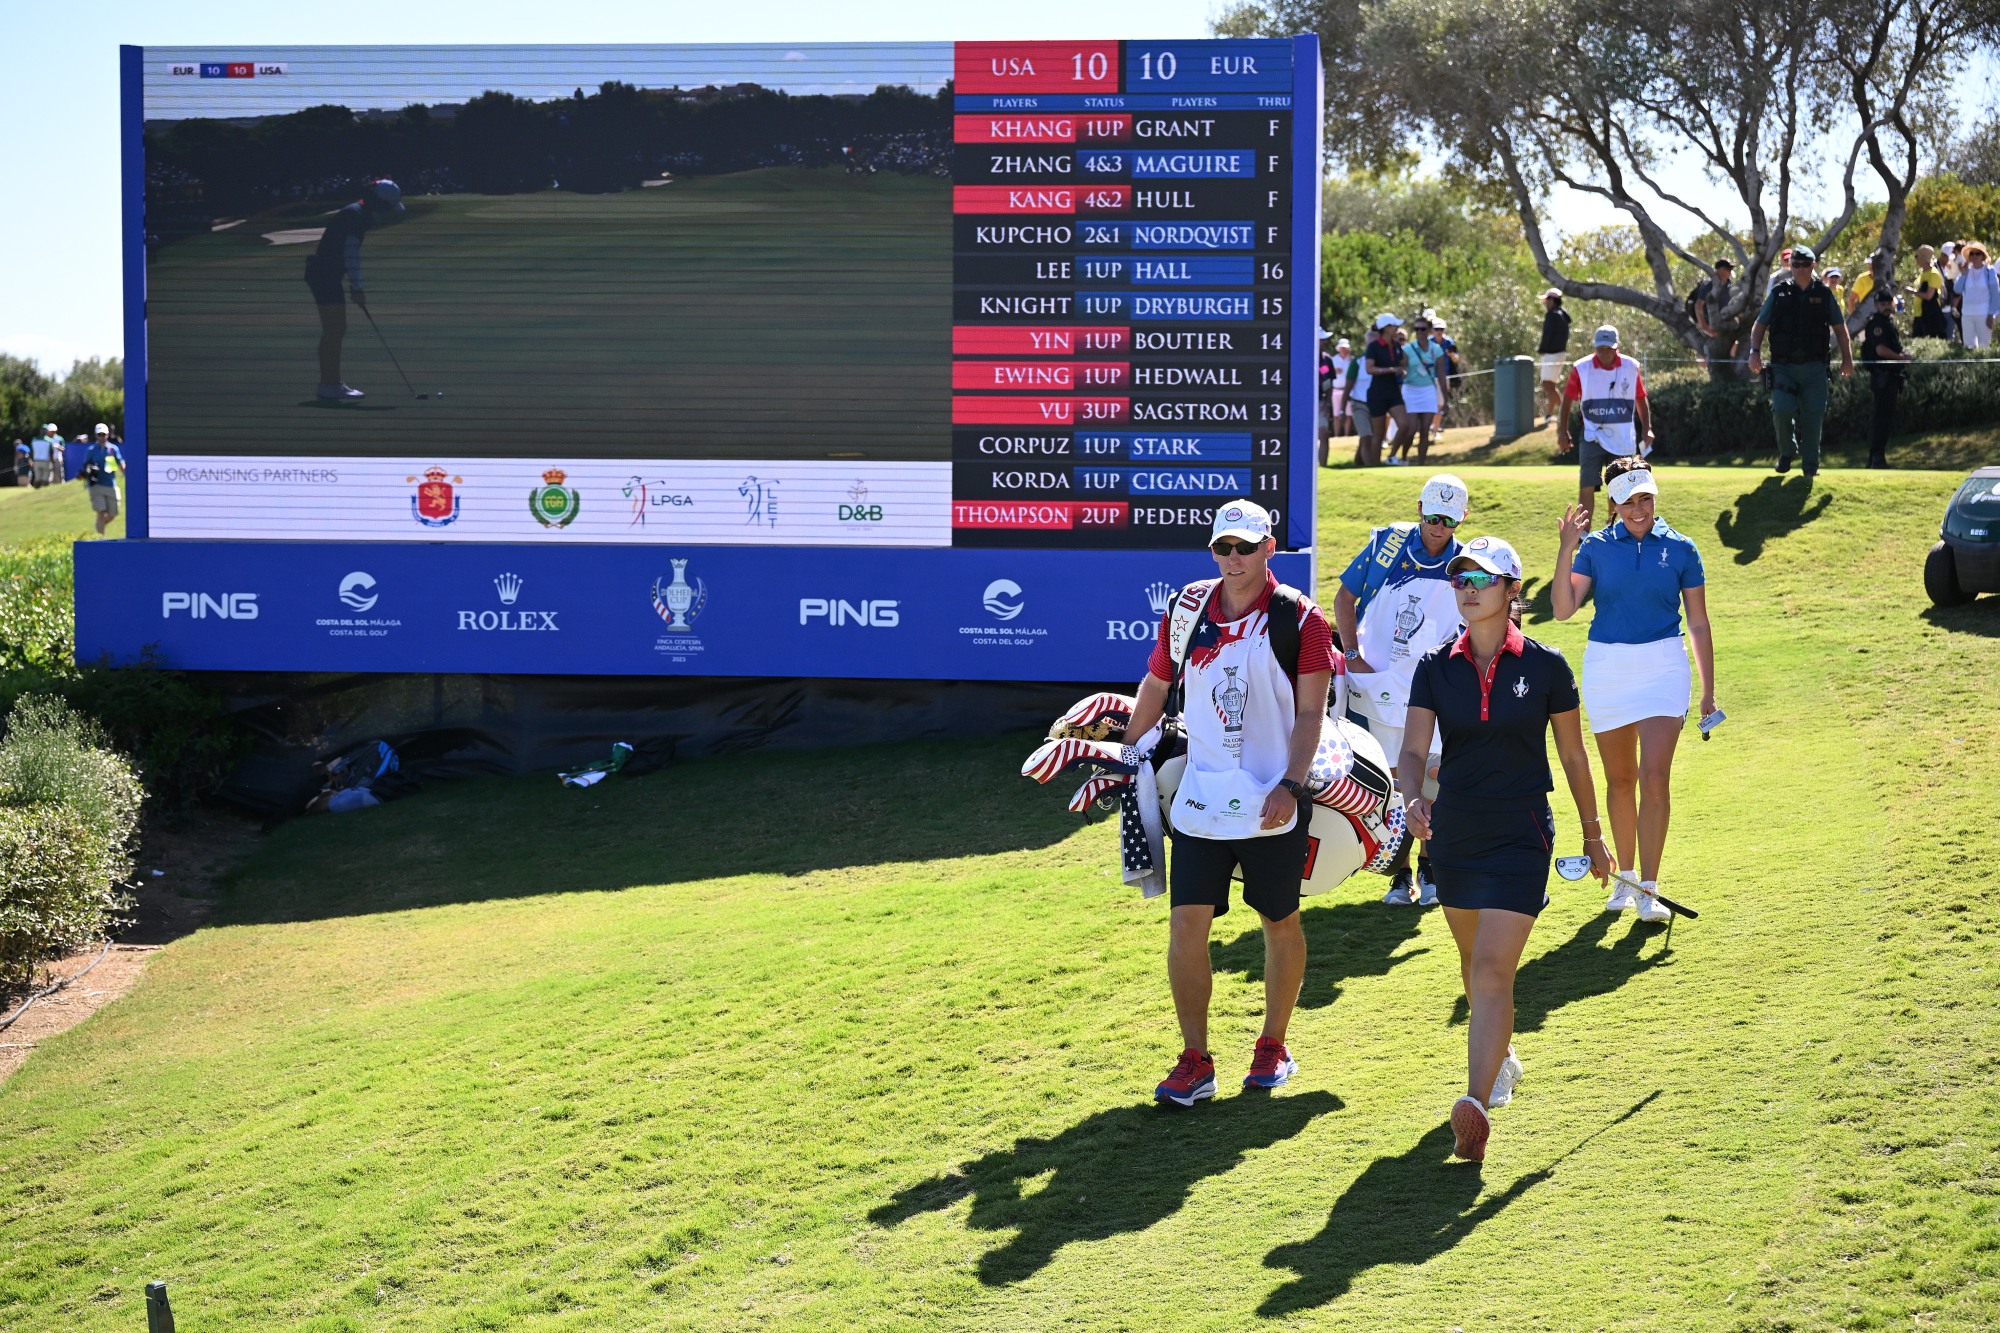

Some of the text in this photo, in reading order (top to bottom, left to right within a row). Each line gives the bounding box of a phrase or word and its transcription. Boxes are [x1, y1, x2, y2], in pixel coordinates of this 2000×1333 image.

[173, 66, 194, 75] EUR
[207, 66, 220, 75] 10
[234, 66, 247, 75] 10
[260, 66, 282, 75] USA
[991, 58, 1036, 77] USA
[1071, 52, 1108, 81] 10
[1140, 51, 1177, 80] 10
[1210, 56, 1258, 75] EUR
[993, 98, 1038, 108] PLAYERS
[1084, 97, 1124, 108] STATUS
[1172, 97, 1217, 107] PLAYERS
[1257, 96, 1291, 107] THRU
[990, 120, 1072, 138] KHANG
[1086, 120, 1123, 137] 1UP
[1136, 119, 1215, 137] GRANT
[1269, 119, 1279, 136] F
[990, 156, 1072, 173] ZHANG
[1085, 155, 1122, 172] 4&3
[1136, 155, 1240, 173] MAGUIRE
[1269, 155, 1279, 172] F
[1009, 191, 1072, 209] KANG
[1085, 191, 1122, 208] 4&2
[1137, 191, 1195, 208] HULL
[1268, 191, 1278, 208] F
[976, 226, 1072, 244] KUPCHO
[1085, 226, 1120, 243] 2&1
[1135, 226, 1252, 248] NORDQVIST
[1268, 226, 1278, 243] F
[1036, 262, 1071, 279] LEE
[1085, 262, 1122, 279] 1UP
[1135, 262, 1192, 280] HALL
[1262, 262, 1284, 279] 16
[980, 297, 1071, 315] KNIGHT
[1085, 297, 1122, 314] 1UP
[1135, 297, 1249, 315] DRYBURGH
[1261, 298, 1283, 315] 15
[1030, 332, 1070, 349] YIN
[1085, 332, 1122, 349] 1UP
[1135, 332, 1234, 350] BOUTIER
[1260, 333, 1283, 350] 14
[994, 367, 1070, 385] EWING
[1084, 367, 1121, 384] 1UP
[1134, 368, 1242, 385] HEDWALL
[1260, 368, 1283, 385] 14
[1039, 402, 1070, 420] VU
[1082, 402, 1121, 419] 3UP
[1133, 402, 1248, 420] SAGSTROM
[1259, 403, 1282, 420] 13
[1588, 407, 1627, 416] MEDIA TV
[979, 437, 1070, 454] CORPUZ
[1083, 437, 1121, 454] 1UP
[1133, 438, 1202, 456] STARK
[1259, 439, 1281, 456] 12
[166, 468, 338, 483] ORGANISING PARTNERS
[992, 472, 1070, 489] KORDA
[1083, 472, 1120, 489] 1UP
[1132, 473, 1239, 490] CIGANDA
[1259, 474, 1279, 491] 11
[651, 495, 693, 506] LPGA
[838, 504, 883, 521] D&B
[955, 506, 1069, 524] THOMPSON
[1082, 507, 1120, 525] 2UP
[1134, 508, 1220, 526] PEDERS
[1269, 508, 1280, 526] 0
[162, 592, 259, 619] PING
[800, 599, 899, 628] PING
[457, 611, 559, 631] ROLEX
[369, 629, 388, 637] GOLF
[999, 627, 1014, 635] SOL
